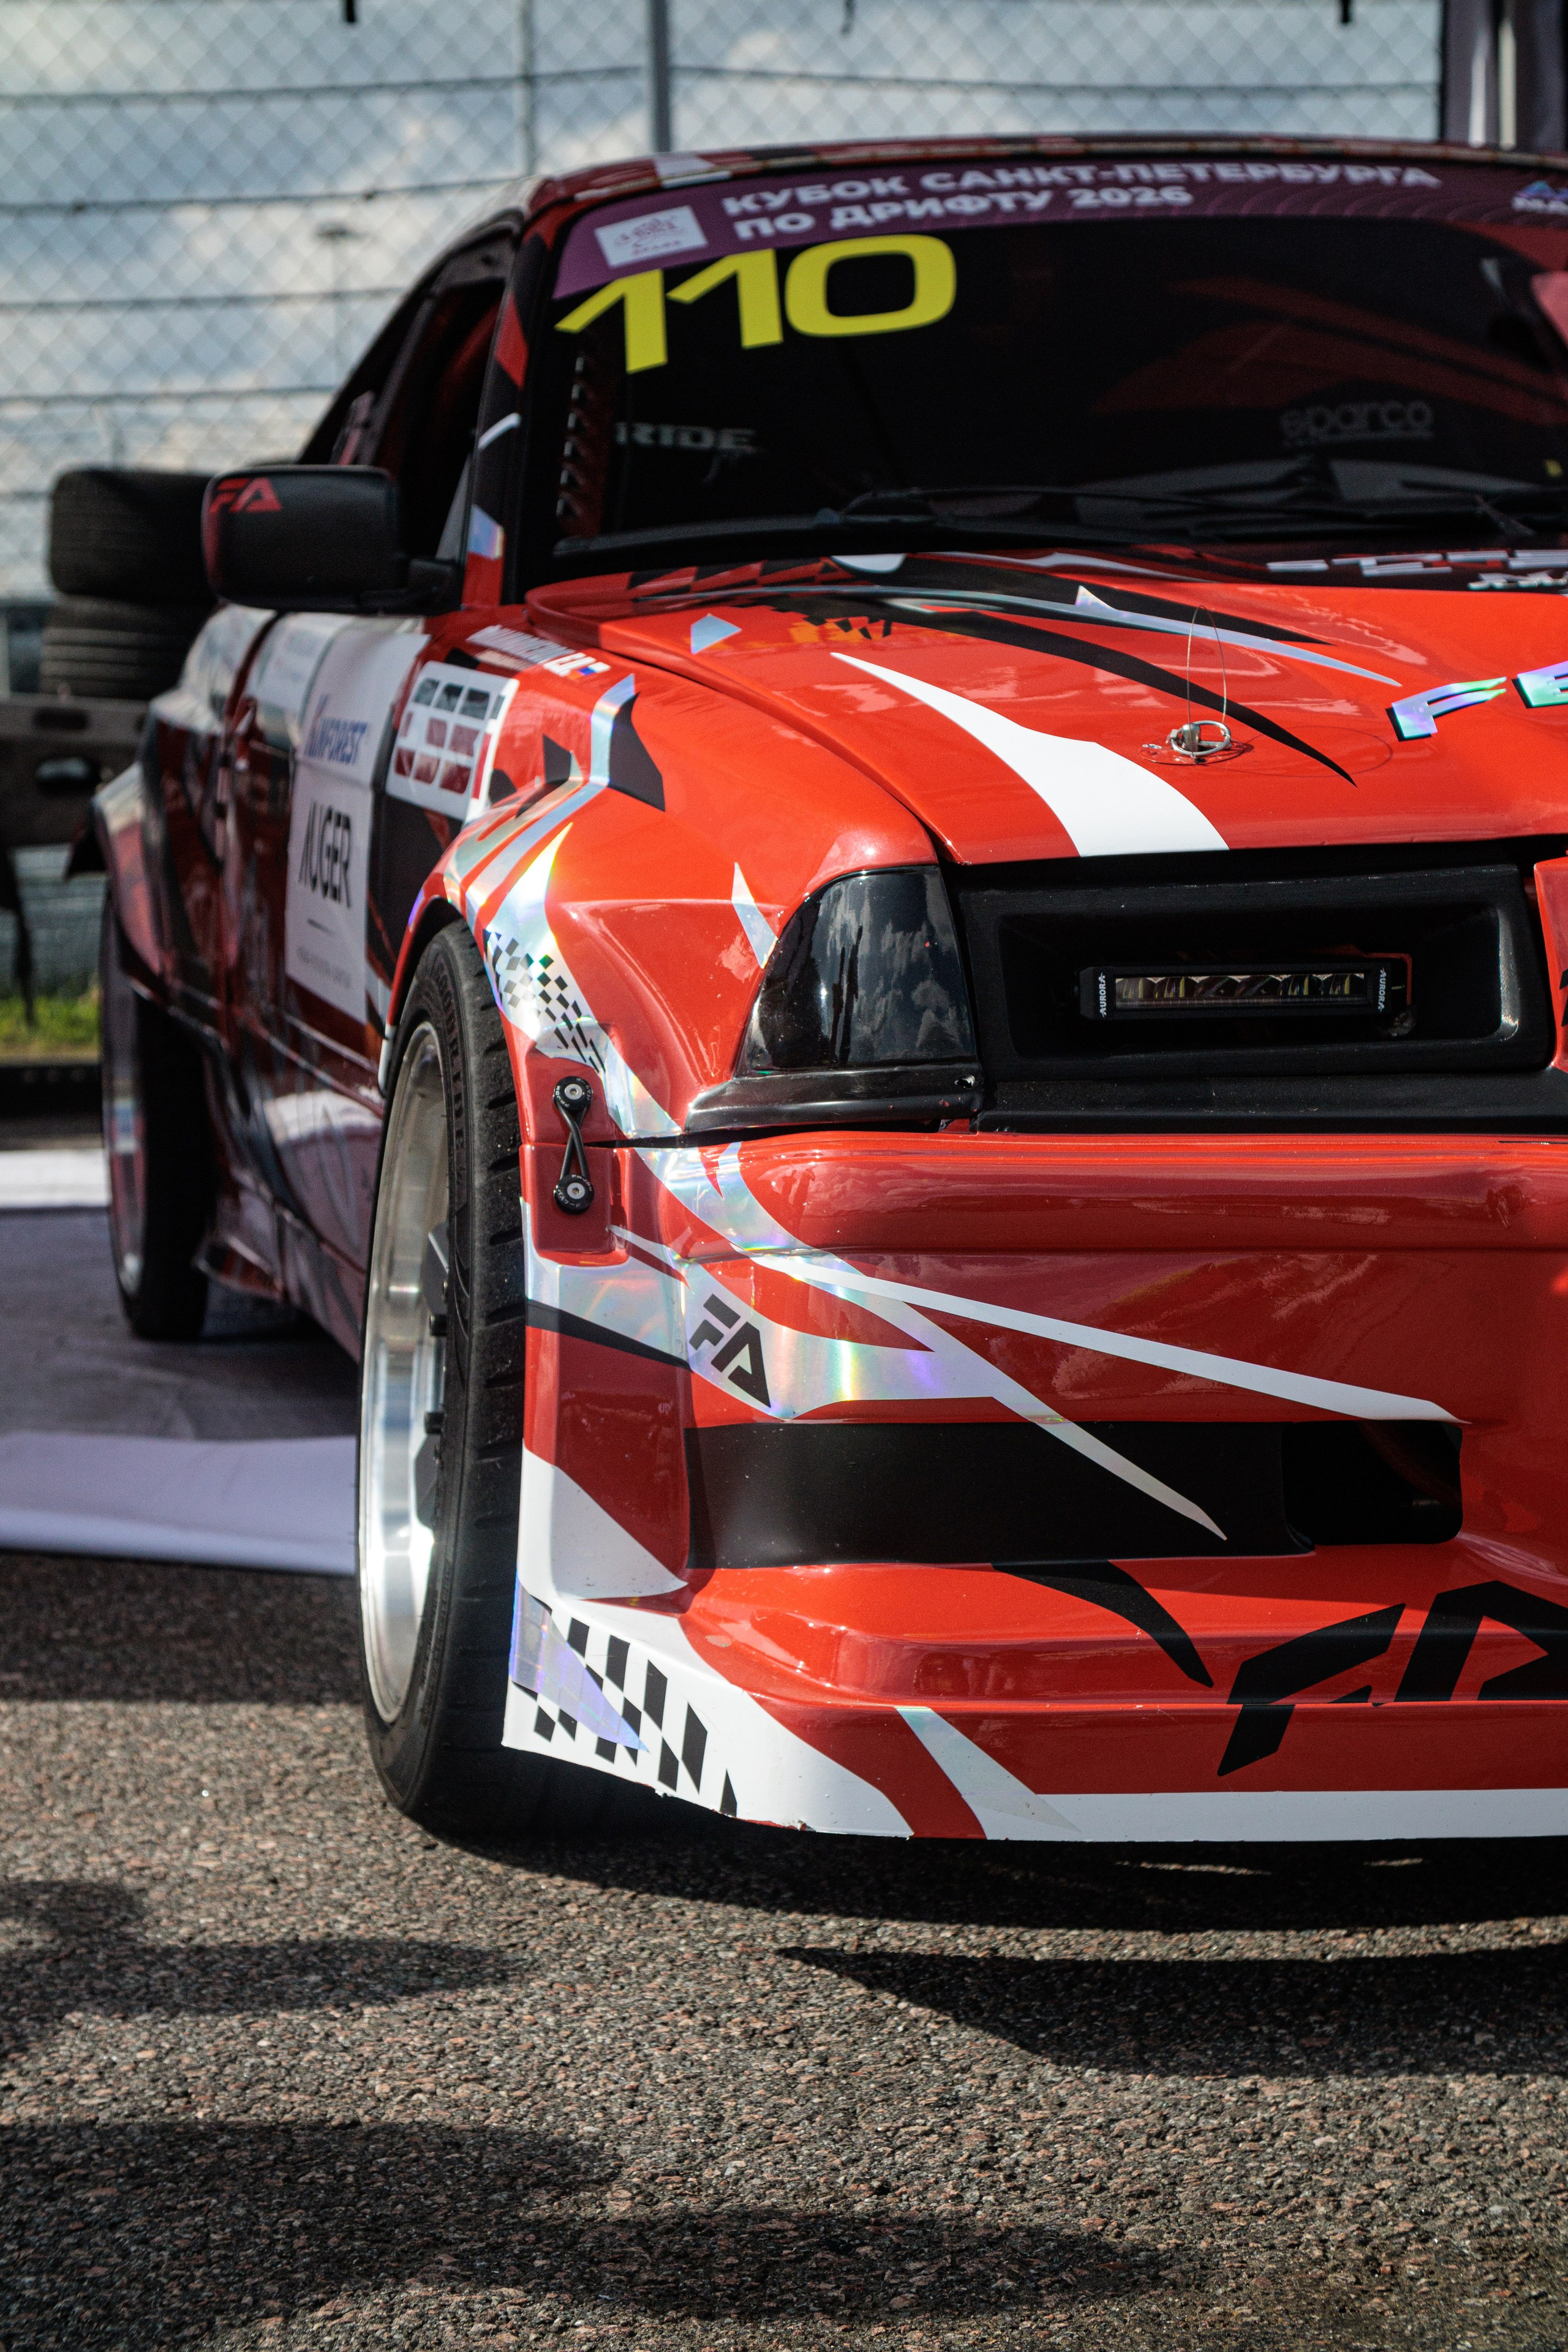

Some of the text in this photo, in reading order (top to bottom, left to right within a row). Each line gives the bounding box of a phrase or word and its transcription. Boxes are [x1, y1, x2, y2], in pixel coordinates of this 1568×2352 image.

[722, 162, 1442, 216] КУБОК САНКТ-ПЕТЕРБУРГА
[733, 186, 1194, 240] ПО ДРИФТУ 2026
[554, 233, 957, 374] 110
[1279, 399, 1434, 445] sparco
[209, 477, 282, 513] FA
[1098, 972, 1107, 1018] AURORA
[1378, 967, 1387, 1012] AURORA
[689, 1294, 771, 1408] FA
